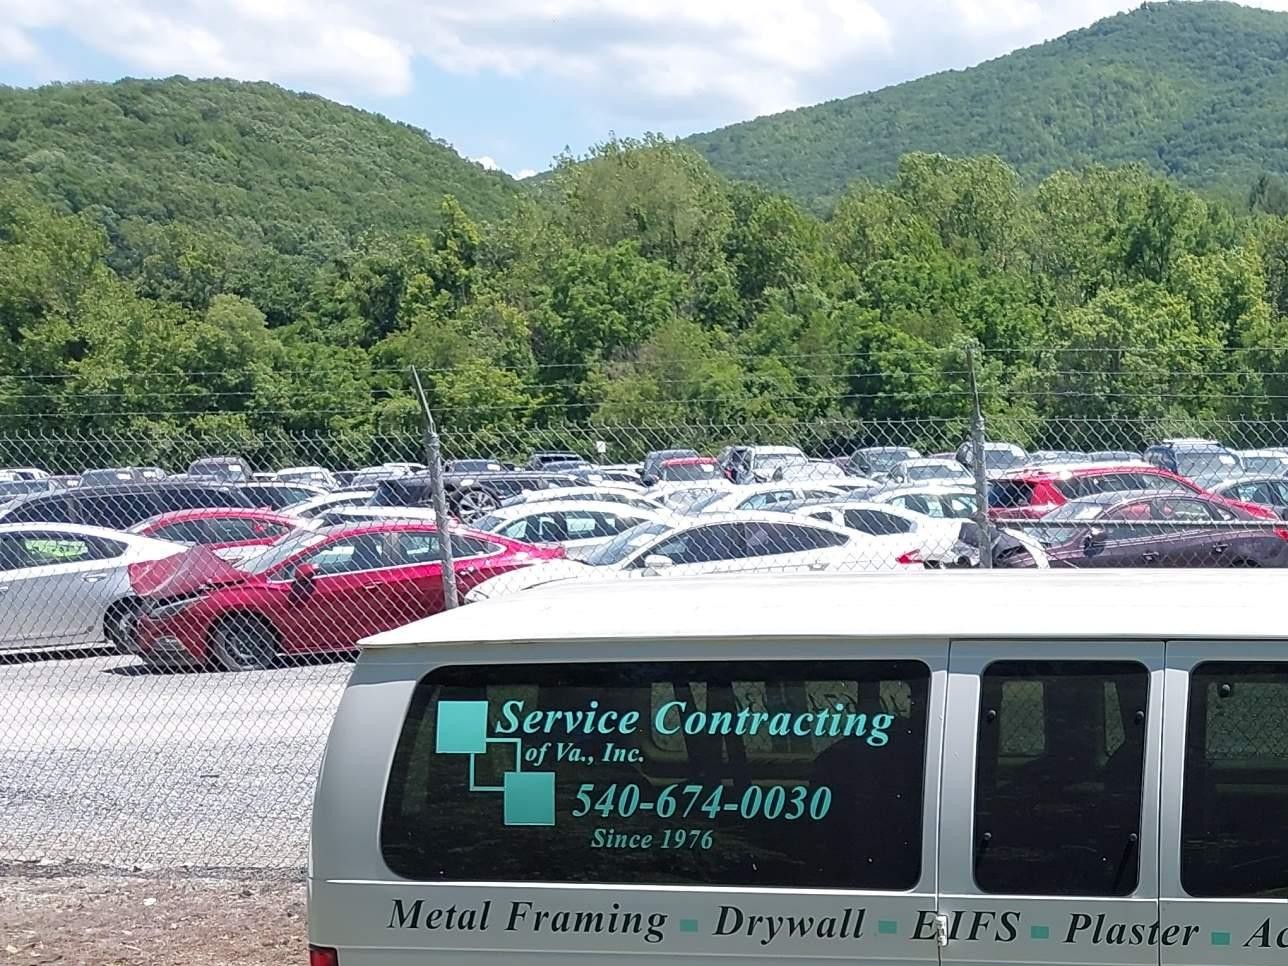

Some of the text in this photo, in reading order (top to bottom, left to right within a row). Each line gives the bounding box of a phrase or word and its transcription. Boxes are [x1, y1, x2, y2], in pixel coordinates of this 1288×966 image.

[495, 700, 895, 746] Service Contracting
[525, 742, 644, 766] of Va., Inc.
[573, 783, 832, 820] 540-674-0030
[590, 828, 713, 850] Since 1976
[387, 899, 492, 931] Metal
[503, 901, 668, 943] Framing
[712, 905, 867, 946] Drywall
[910, 910, 1021, 942] EIFS
[1063, 913, 1200, 946] Plaster
